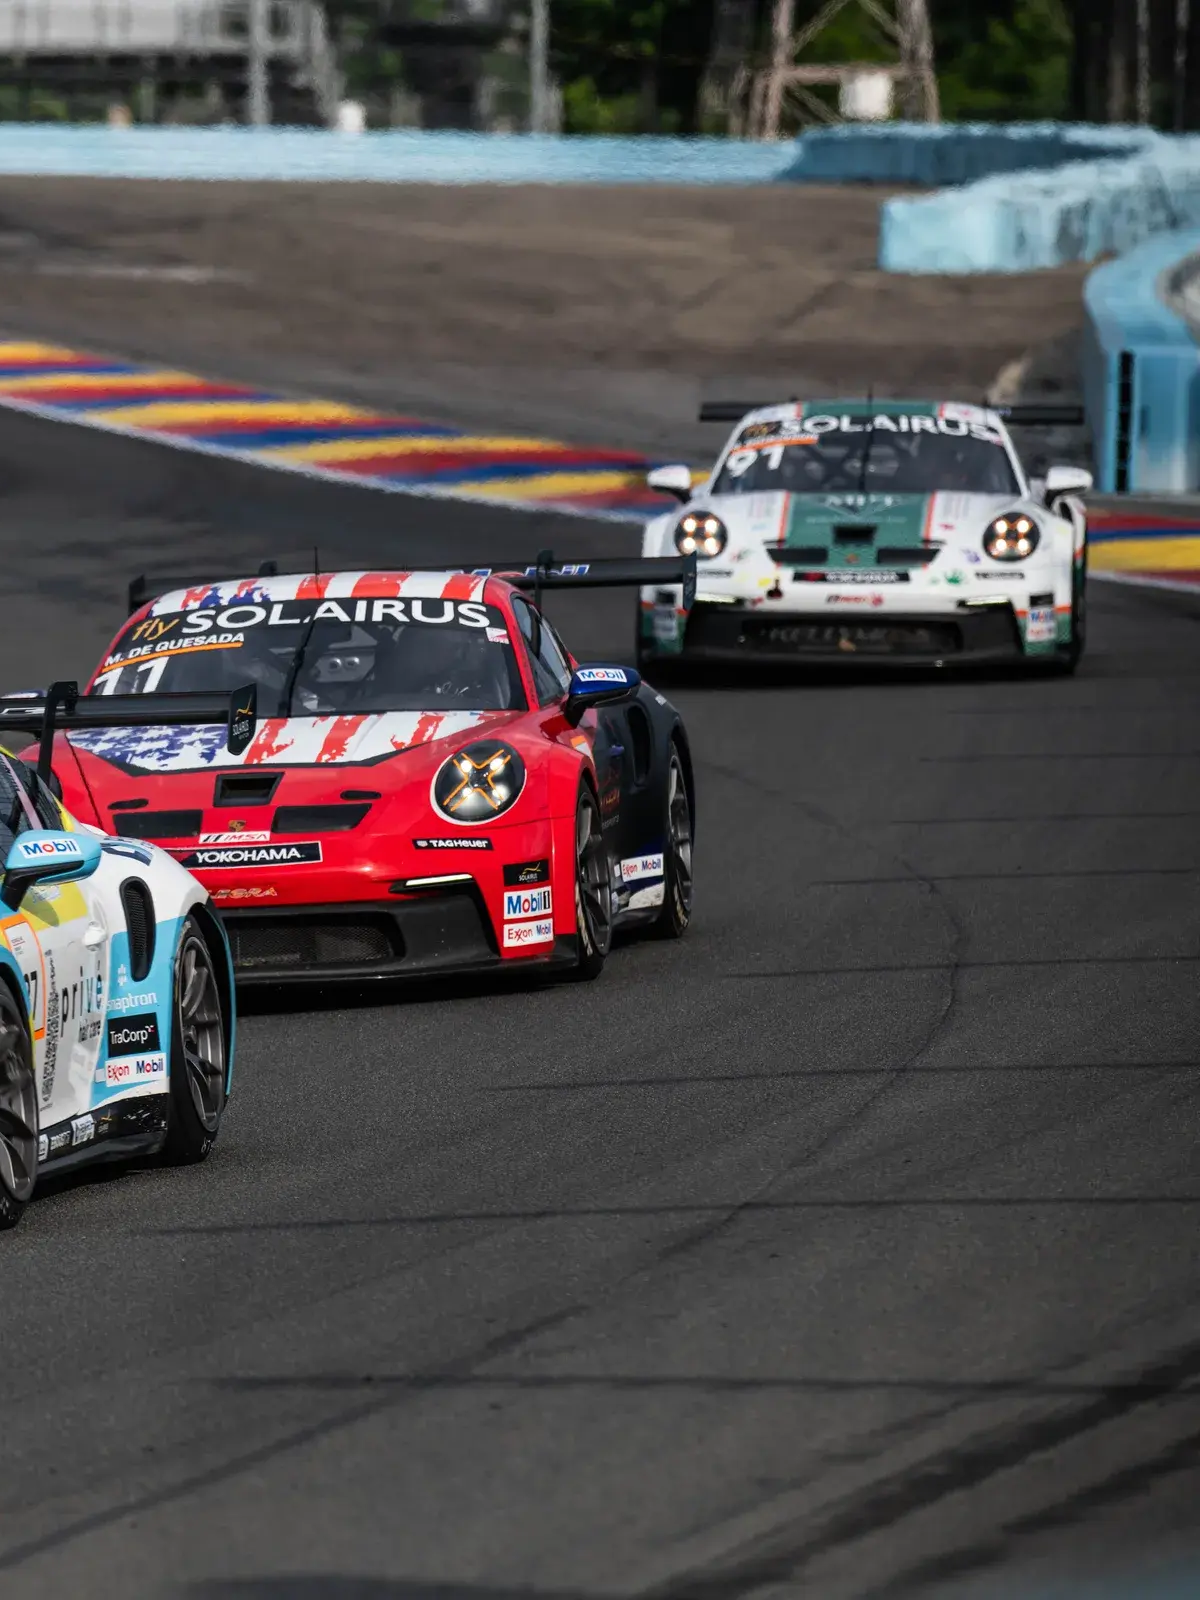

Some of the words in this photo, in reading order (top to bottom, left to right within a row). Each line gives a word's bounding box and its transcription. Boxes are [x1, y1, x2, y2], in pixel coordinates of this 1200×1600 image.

[779, 414, 1004, 443] SOLAIRUS
[726, 445, 786, 476] 91
[132, 618, 179, 641] fly
[181, 600, 490, 634] SOLAIRUS
[105, 652, 123, 666] M.
[128, 644, 154, 658] DE
[155, 632, 245, 652] QUESADA
[93, 656, 170, 695] 11
[580, 669, 624, 682] Mobil
[23, 840, 77, 855] Mobil
[196, 847, 301, 863] YOKOHAMA
[641, 858, 661, 871] Mobil
[507, 893, 542, 915] Mobil
[508, 928, 533, 942] Exxon
[536, 923, 551, 935] Mobil
[107, 992, 157, 1013] snaptron
[110, 1029, 148, 1044] TraCorp
[107, 1065, 130, 1081] Exxon
[136, 1059, 164, 1074] Mobil
